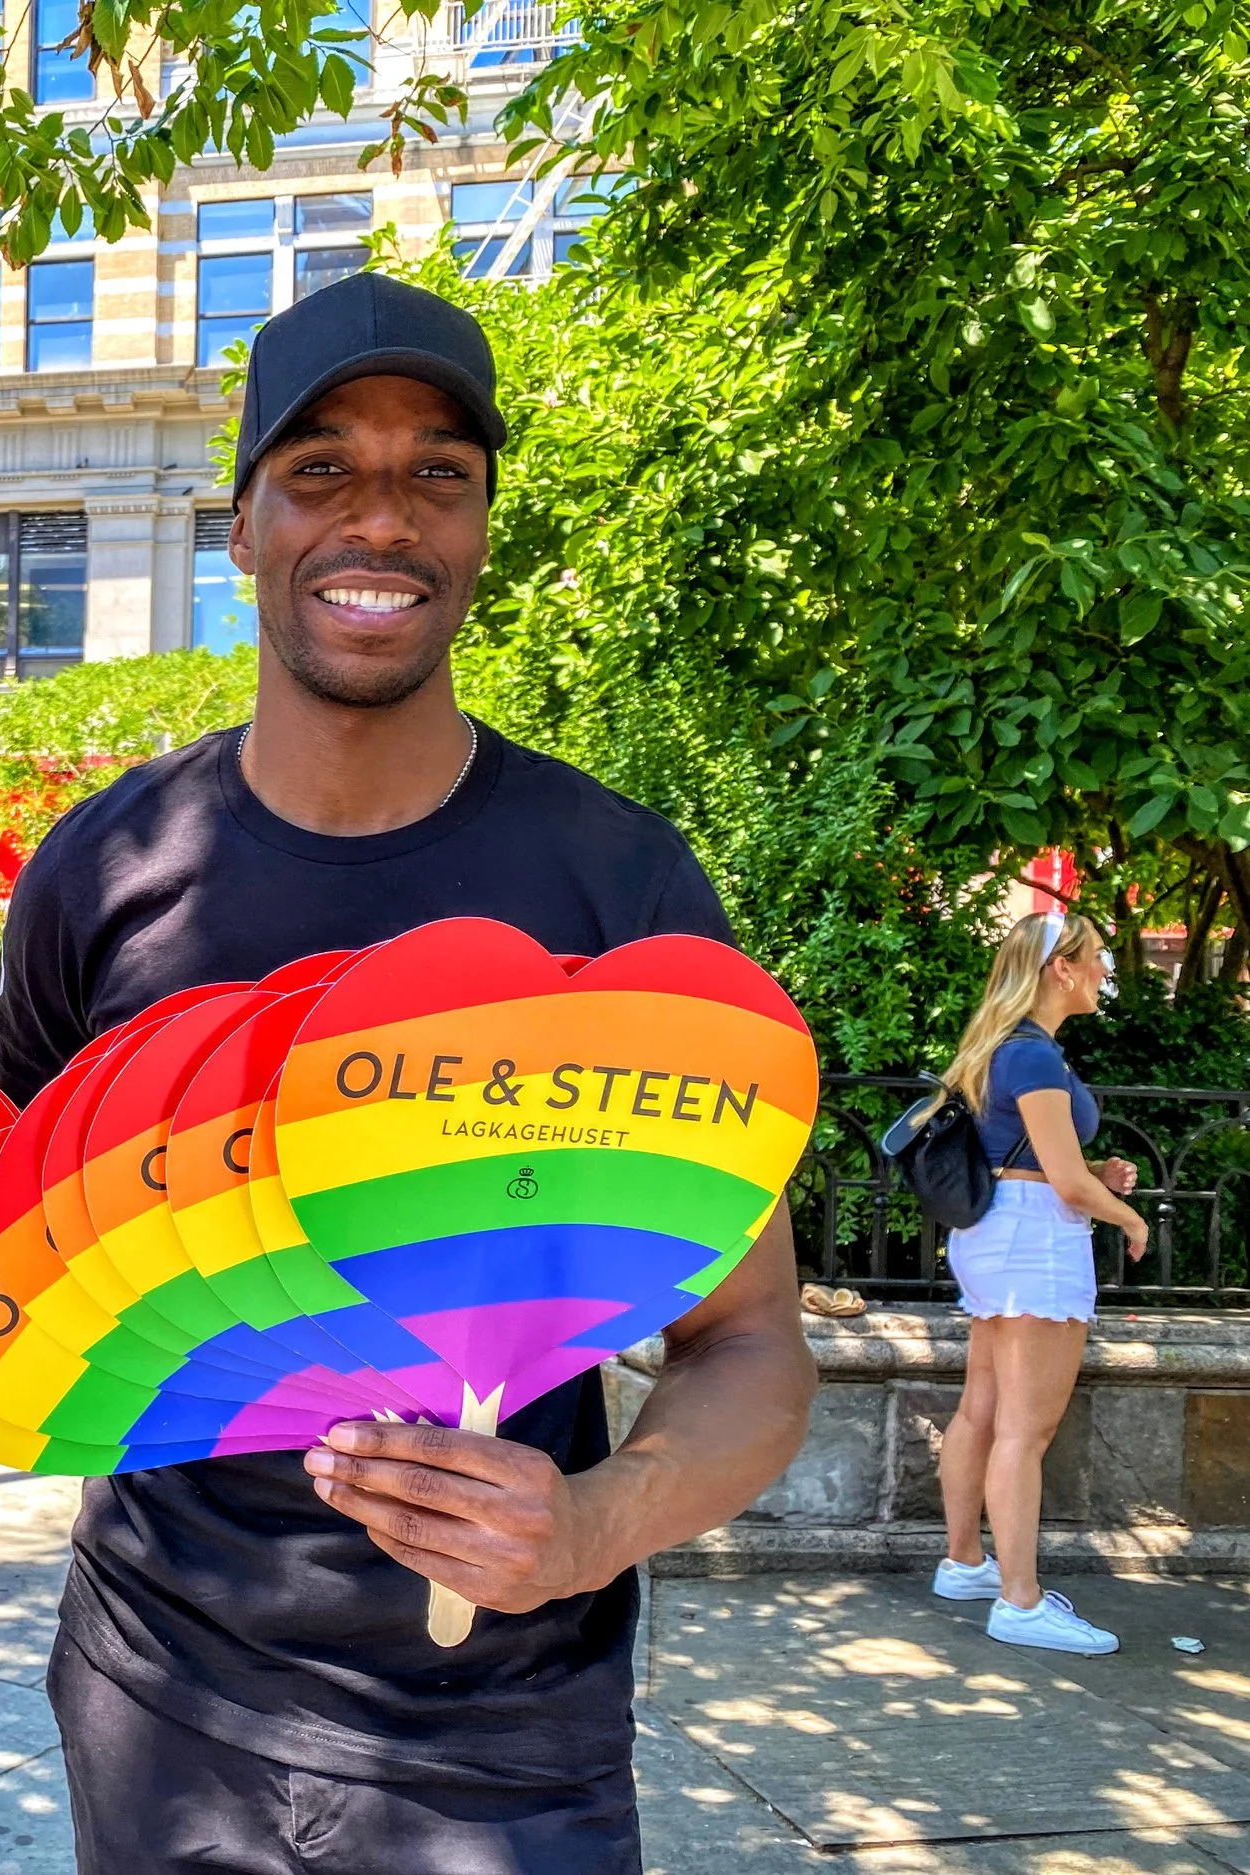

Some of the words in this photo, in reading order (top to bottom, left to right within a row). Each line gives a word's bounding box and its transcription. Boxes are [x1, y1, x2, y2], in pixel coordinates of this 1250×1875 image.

[336, 1051, 463, 1101] OLE
[482, 1059, 525, 1106] &
[545, 1063, 759, 1128] STEEN
[442, 1119, 630, 1148] LAGKAGEHUSET
